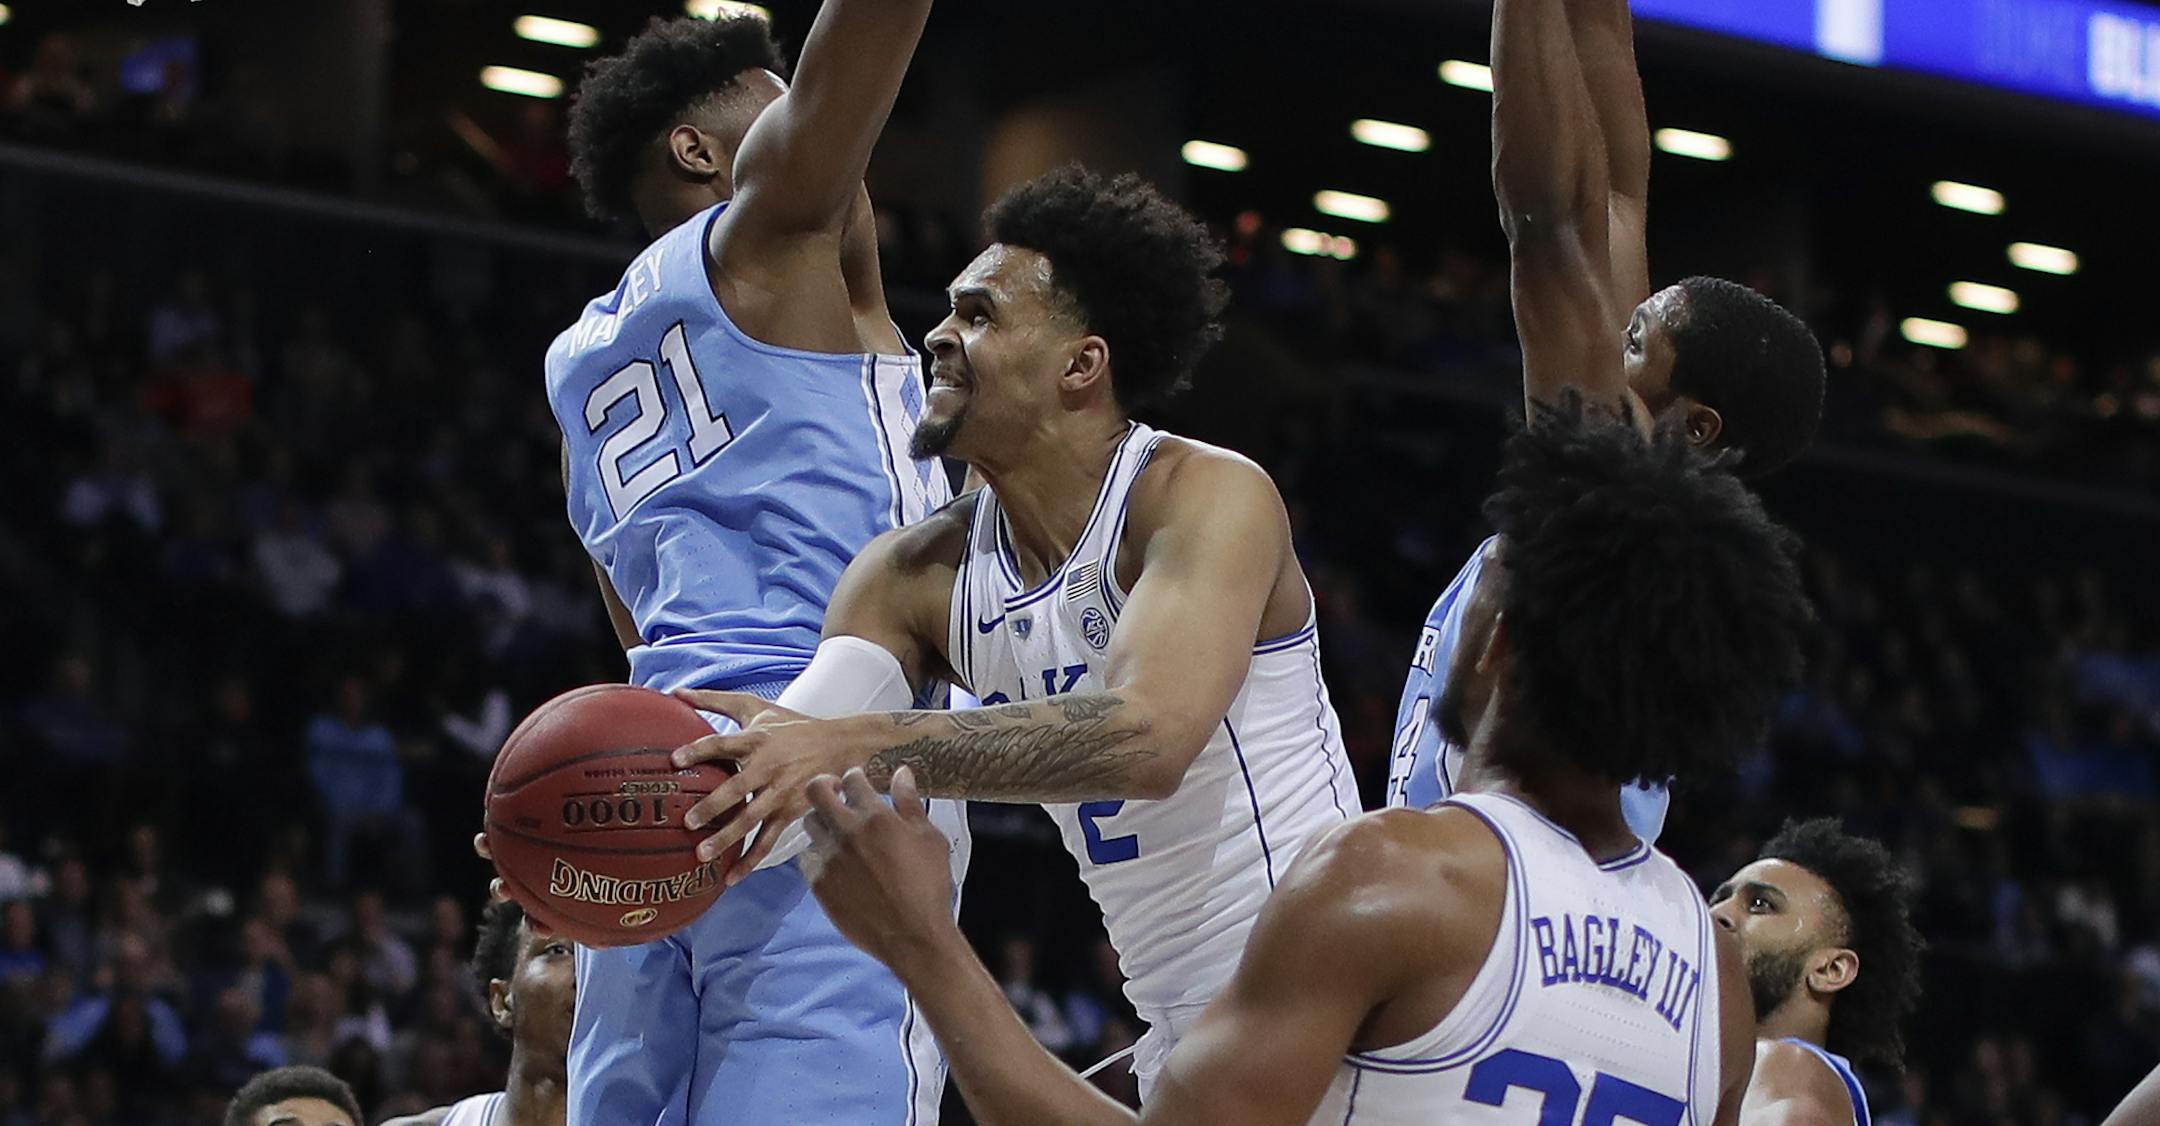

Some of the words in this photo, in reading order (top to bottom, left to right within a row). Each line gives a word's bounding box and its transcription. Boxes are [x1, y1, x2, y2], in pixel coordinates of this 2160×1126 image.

[584, 319, 735, 524] 21
[562, 797, 704, 828] -1000
[550, 857, 722, 905] SPALDING
[1530, 913, 1662, 1001] BAGLEY
[1655, 950, 1700, 1034] III
